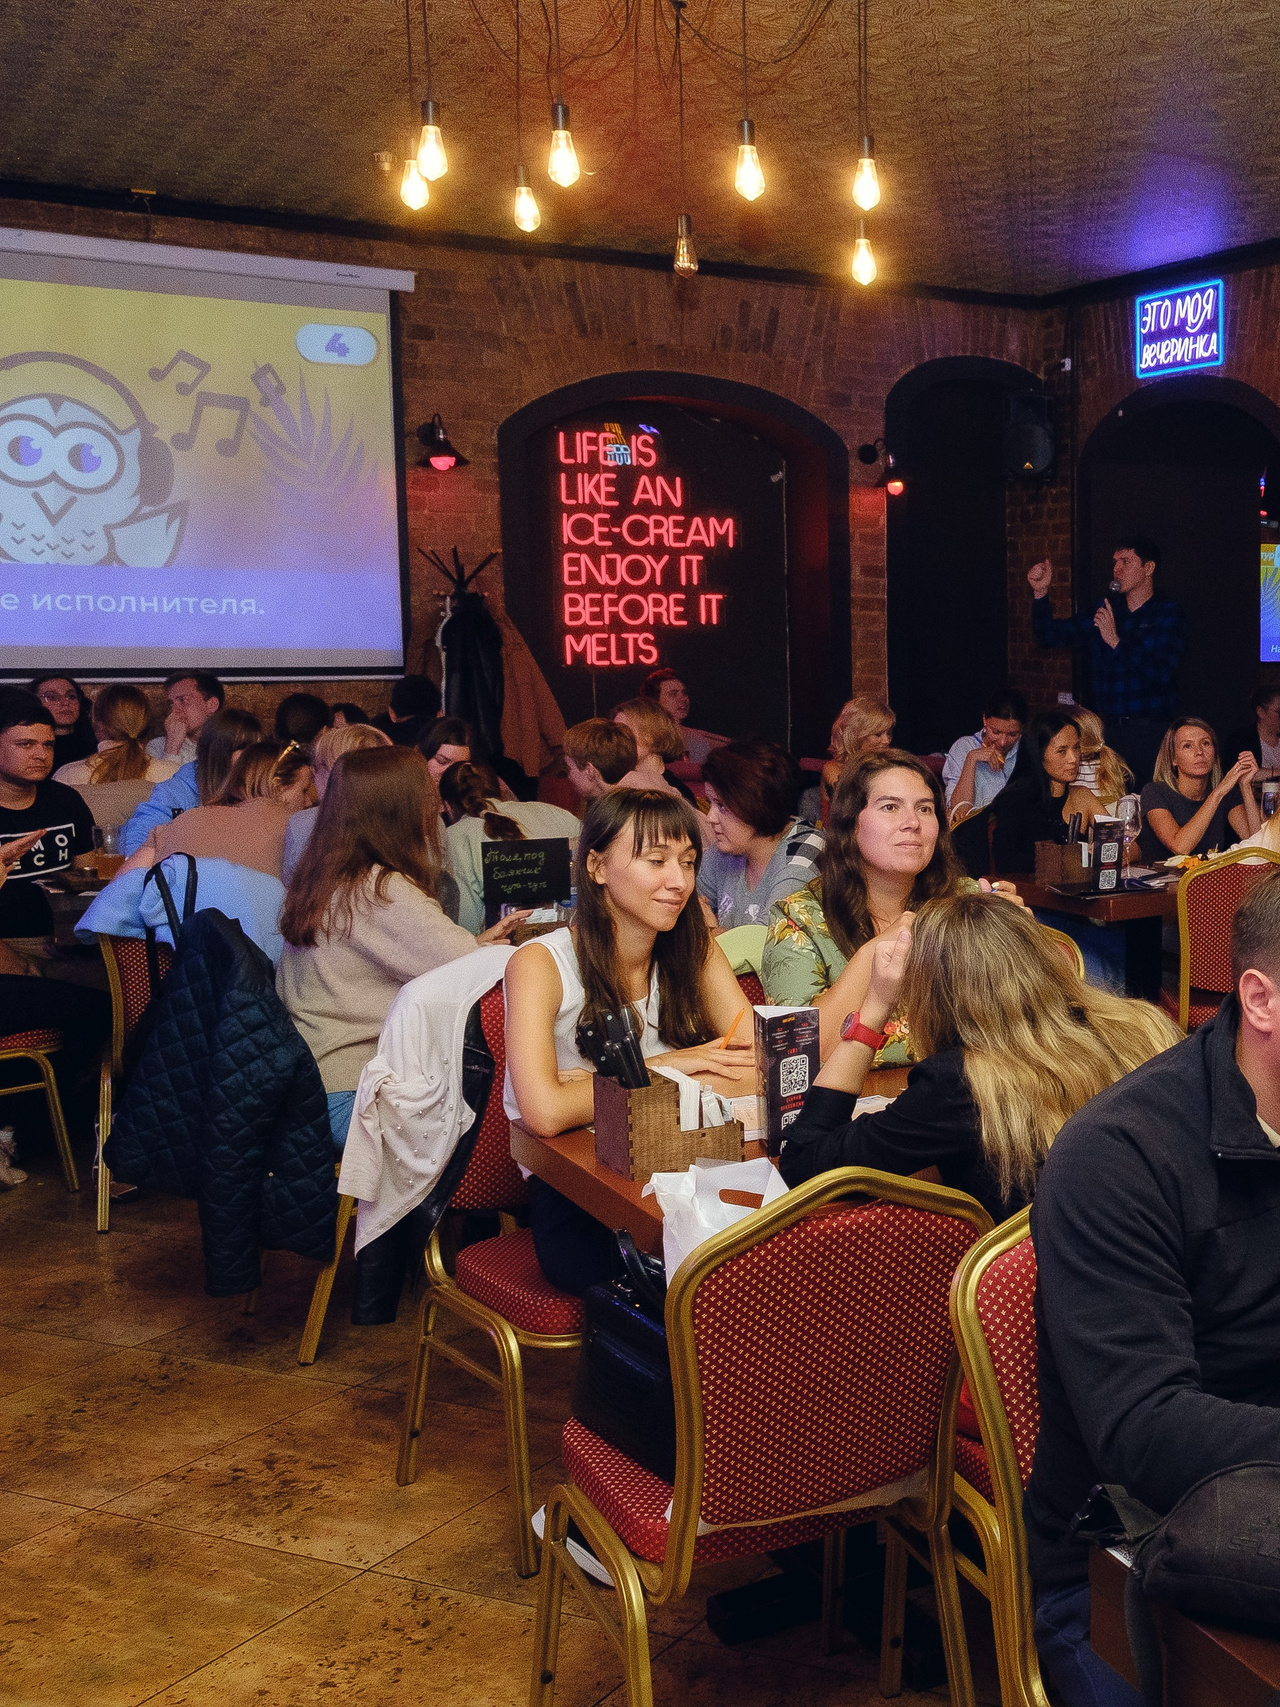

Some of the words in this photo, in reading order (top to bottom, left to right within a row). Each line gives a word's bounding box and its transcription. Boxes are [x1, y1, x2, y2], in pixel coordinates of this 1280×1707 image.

[1140, 298, 1172, 334] ЭТО
[1173, 288, 1214, 333] МОЯ
[325, 332, 350, 358] 4
[558, 431, 618, 466] LIFE
[631, 434, 657, 468] IS
[560, 472, 619, 506] LIKE
[632, 475, 682, 508] AN
[562, 512, 734, 548] ICE-CREAM
[563, 553, 669, 586] ENJOY
[680, 555, 704, 586] IT
[32, 592, 266, 616] исполнителя.
[563, 593, 688, 626] BEFORE
[700, 594, 723, 625] IT
[564, 632, 658, 665] MELTS
